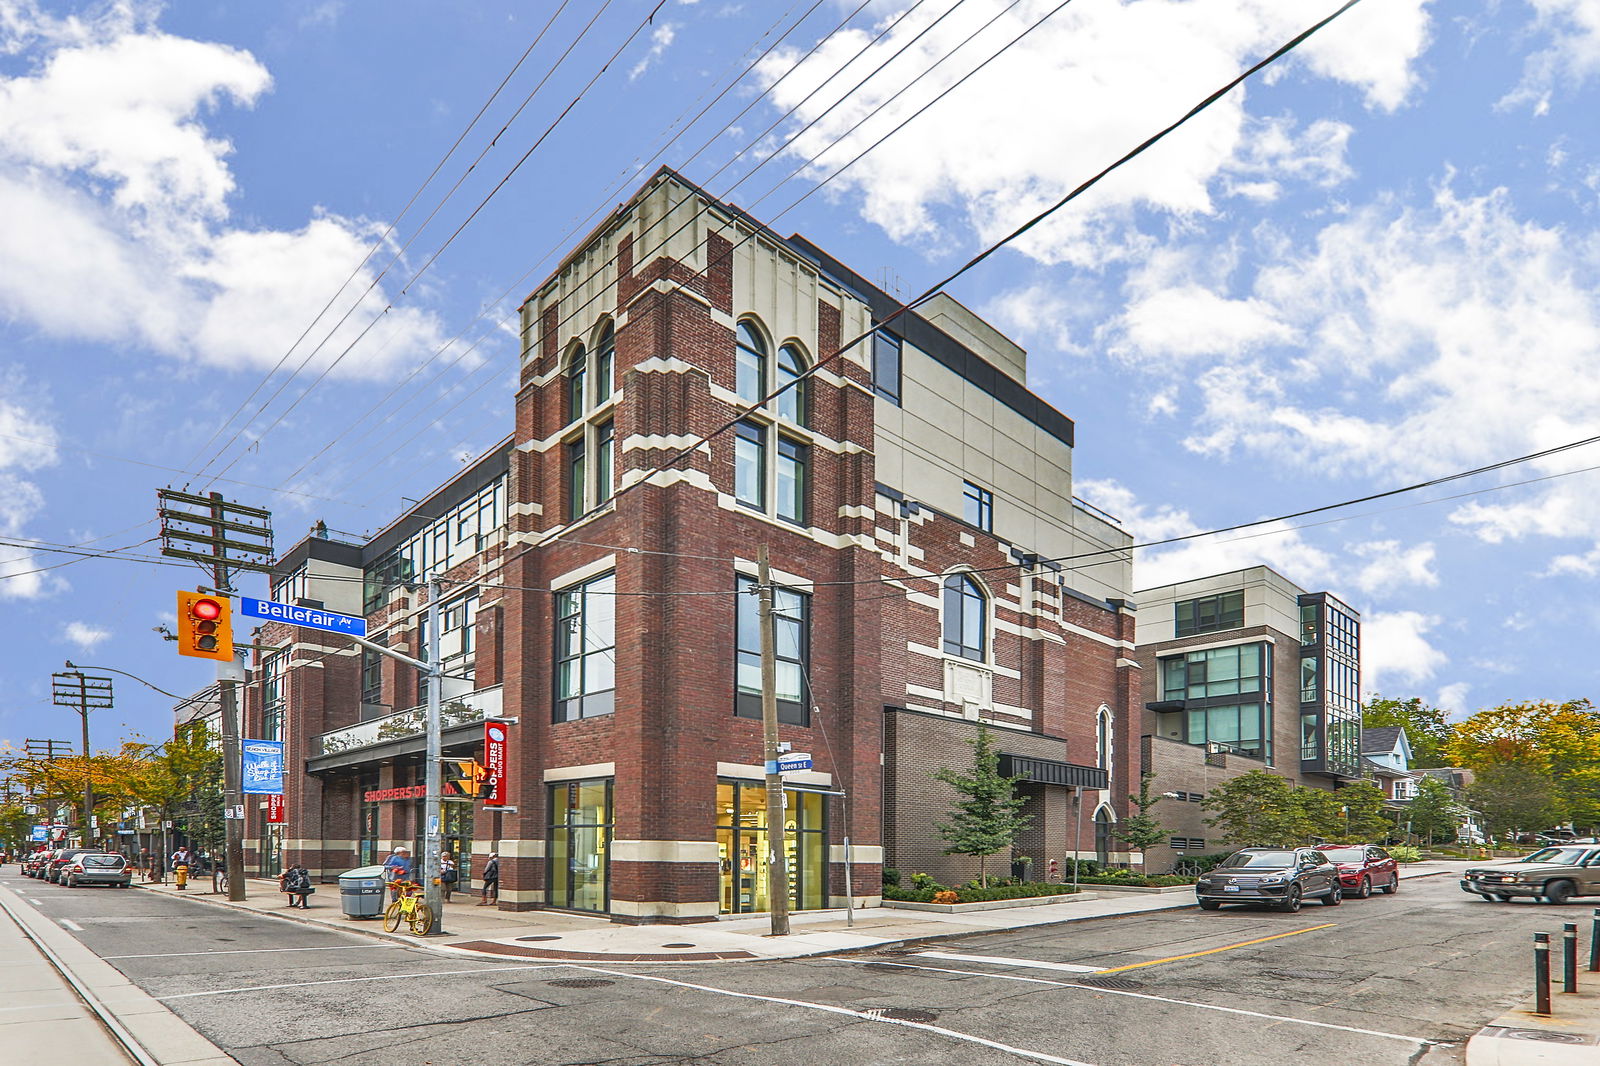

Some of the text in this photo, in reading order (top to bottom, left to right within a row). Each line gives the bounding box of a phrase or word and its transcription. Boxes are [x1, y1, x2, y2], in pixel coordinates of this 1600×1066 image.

[257, 601, 352, 627] Bellefair Av
[364, 786, 413, 802] SHOPPERS
